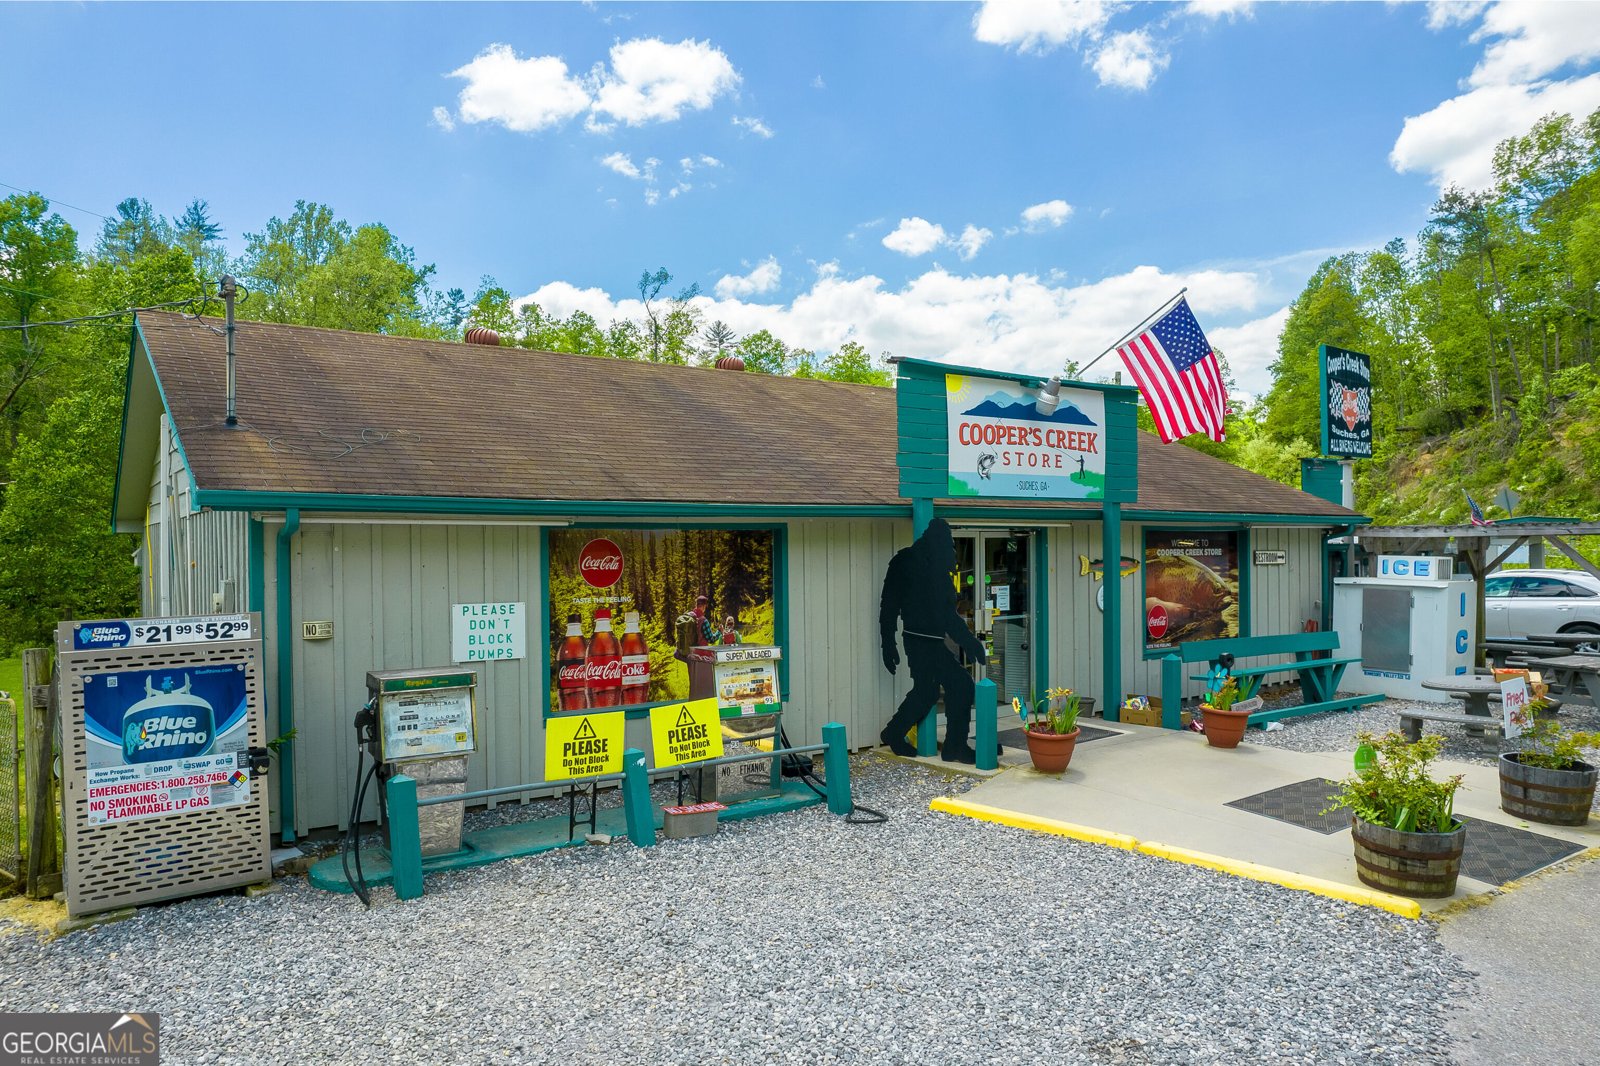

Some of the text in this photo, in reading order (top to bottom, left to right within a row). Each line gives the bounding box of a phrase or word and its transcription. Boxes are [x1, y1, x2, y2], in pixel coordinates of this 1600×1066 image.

[959, 422, 1098, 454] COOPER'S CREEK
[1332, 424, 1370, 440] Suches, GA
[1003, 452, 1063, 469] STORE
[1019, 480, 1048, 491] SUCHES, GA
[1204, 548, 1222, 556] STORE
[581, 556, 621, 571] Coca-Cola
[1382, 559, 1431, 577] ICE
[462, 604, 516, 616] PLEASE
[305, 625, 316, 635] NO
[469, 618, 510, 630] DON'T
[91, 627, 126, 642] Blue Rhino
[468, 633, 513, 645] BLOCK
[468, 648, 513, 660] PUMPS
[726, 650, 771, 661] SUPER UNLEADED
[585, 661, 621, 680] Coca-Cola
[622, 665, 645, 676] Coke
[1506, 688, 1524, 707] Fried
[144, 715, 197, 732] Blue
[138, 730, 207, 750] Rhino
[668, 724, 708, 744] PLEASE
[563, 738, 608, 757] PLEASE
[669, 739, 710, 754] Do Not Block
[563, 754, 609, 767] Do Not Block
[675, 750, 706, 761] This Area
[153, 765, 173, 774] DROP
[191, 760, 211, 769] SWAP
[569, 764, 603, 775] This Area
[722, 762, 765, 777] NO ETHANOL
[110, 768, 134, 776] Propane
[89, 777, 119, 785] Exchange
[90, 794, 158, 812] NO SMOKING
[107, 796, 209, 819] FLAMMABLE LP GAS
